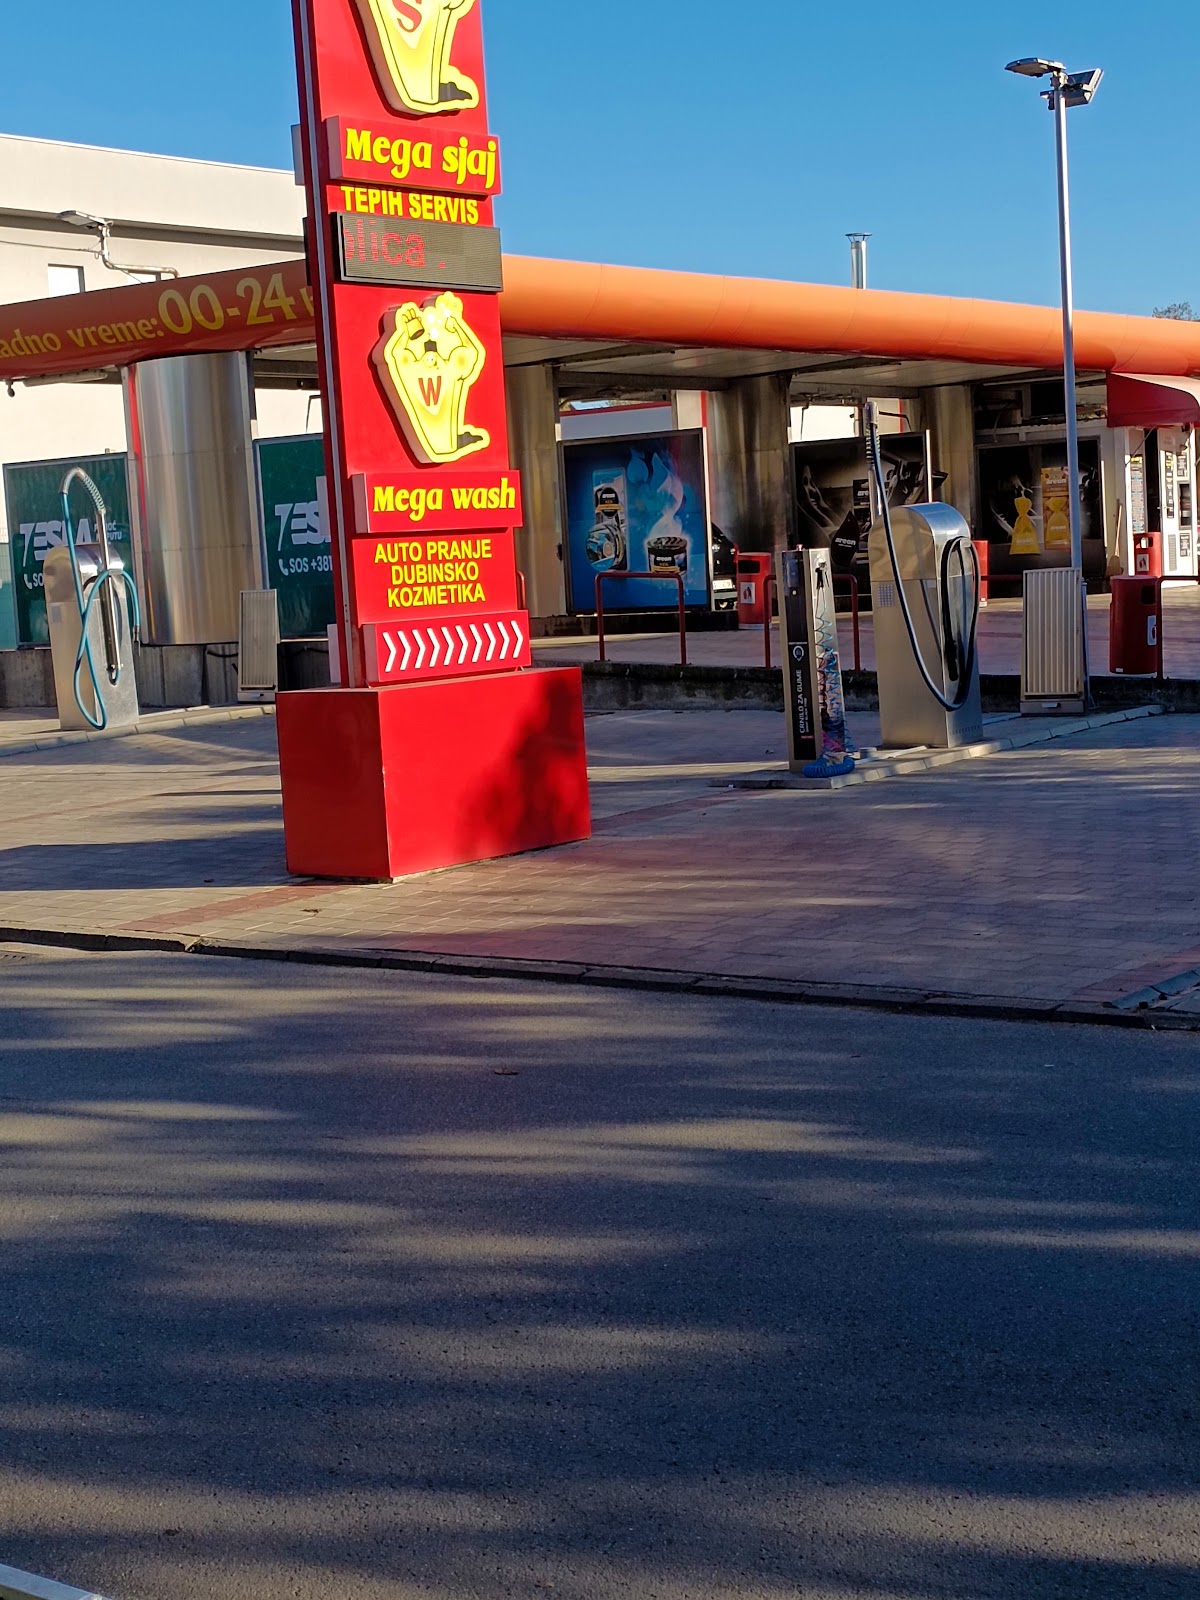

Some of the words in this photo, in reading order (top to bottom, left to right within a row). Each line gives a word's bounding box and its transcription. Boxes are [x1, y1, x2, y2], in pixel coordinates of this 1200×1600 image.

[345, 128, 433, 179] Mega
[442, 136, 497, 189] sjaj
[340, 186, 404, 217] TEPIH
[408, 193, 479, 225] SERVIS
[0, 328, 62, 359] adno
[418, 376, 442, 407] W
[373, 485, 444, 522] Mega
[450, 477, 516, 510] wash
[274, 500, 332, 552] TES
[289, 557, 309, 574] SOS
[374, 541, 422, 564] AUTO
[426, 539, 492, 561] PRANJE
[391, 562, 479, 585] DUBINSKO
[387, 583, 486, 608] KOZMETIKA
[795, 669, 803, 693] GUME
[796, 693, 804, 705] ZA
[797, 705, 806, 734] CRNILO
